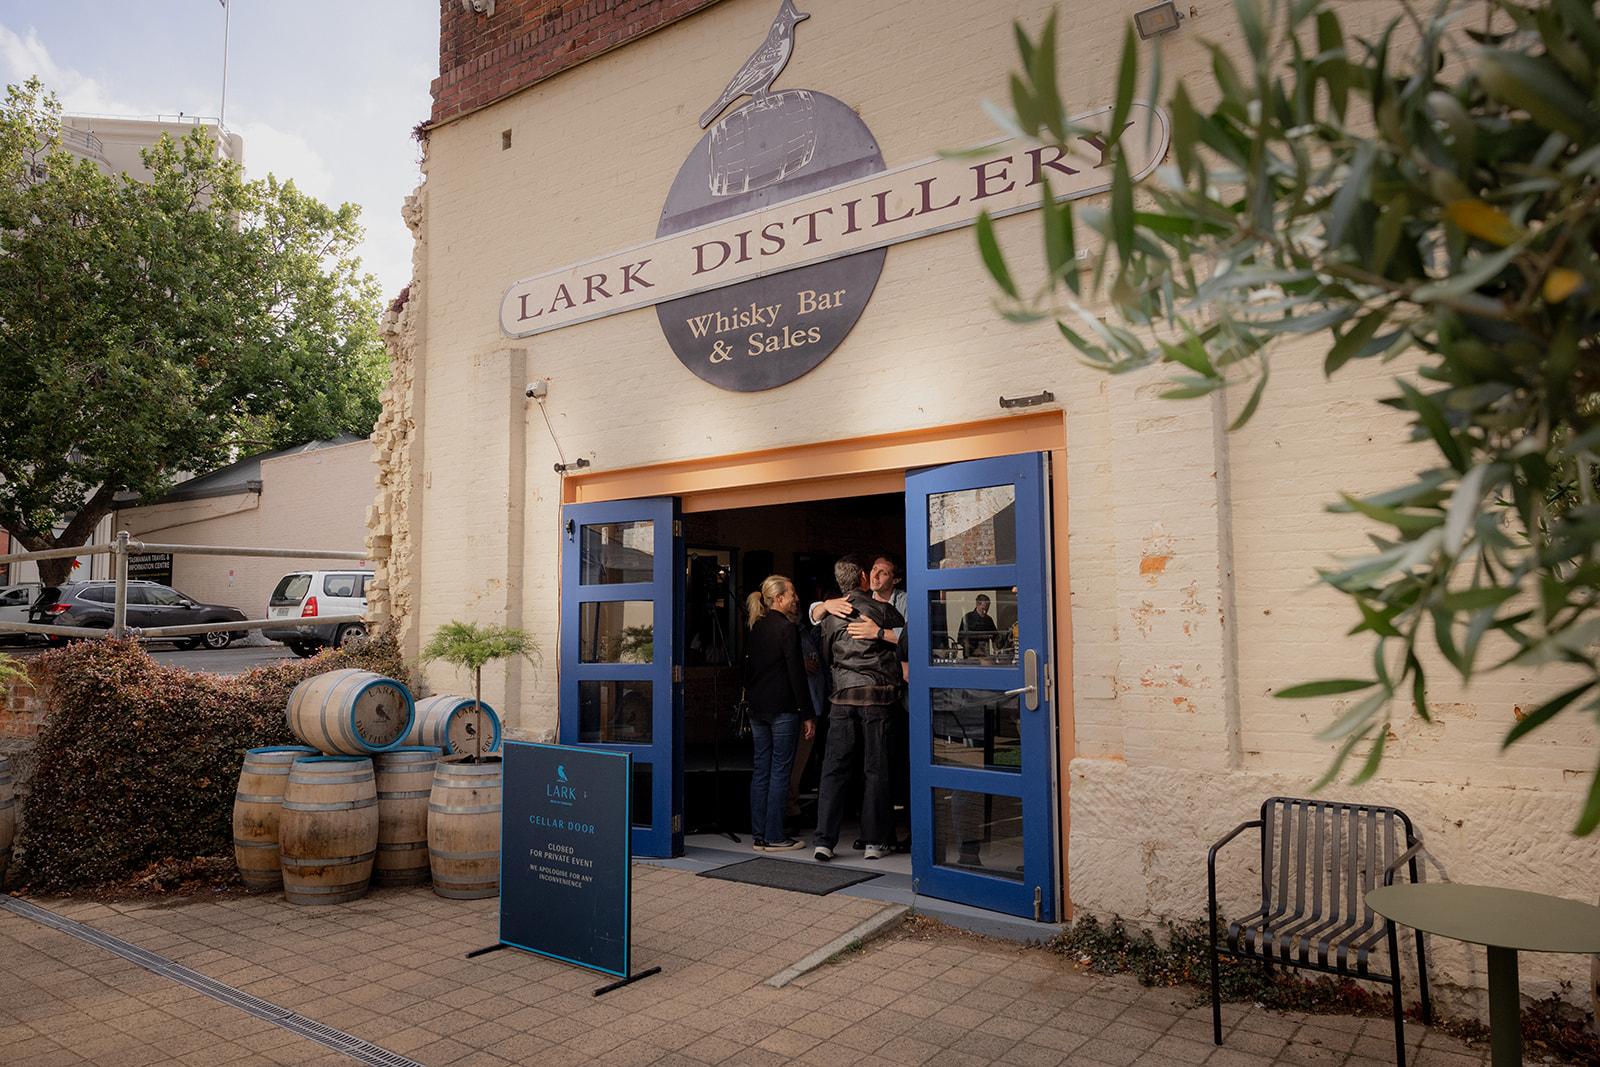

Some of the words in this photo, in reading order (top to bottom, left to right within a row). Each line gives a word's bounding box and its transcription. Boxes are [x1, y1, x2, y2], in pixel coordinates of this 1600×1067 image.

[517, 259, 655, 322] LARK
[691, 121, 1135, 275] DISTILLERY
[687, 302, 782, 339] Whisky
[797, 288, 846, 315] Bar
[709, 340, 734, 364] &
[748, 325, 821, 356] Sales
[546, 783, 577, 800] LARK
[529, 815, 564, 829] CELLAR
[567, 821, 596, 834] DOOR
[529, 848, 543, 858] FOR
[543, 851, 570, 863] PRIVATE
[571, 857, 593, 868] EVENT
[547, 843, 574, 855] CLOSED
[538, 873, 582, 888] INCONVENIENCE
[569, 871, 581, 880] FOR
[581, 875, 593, 883] ANY
